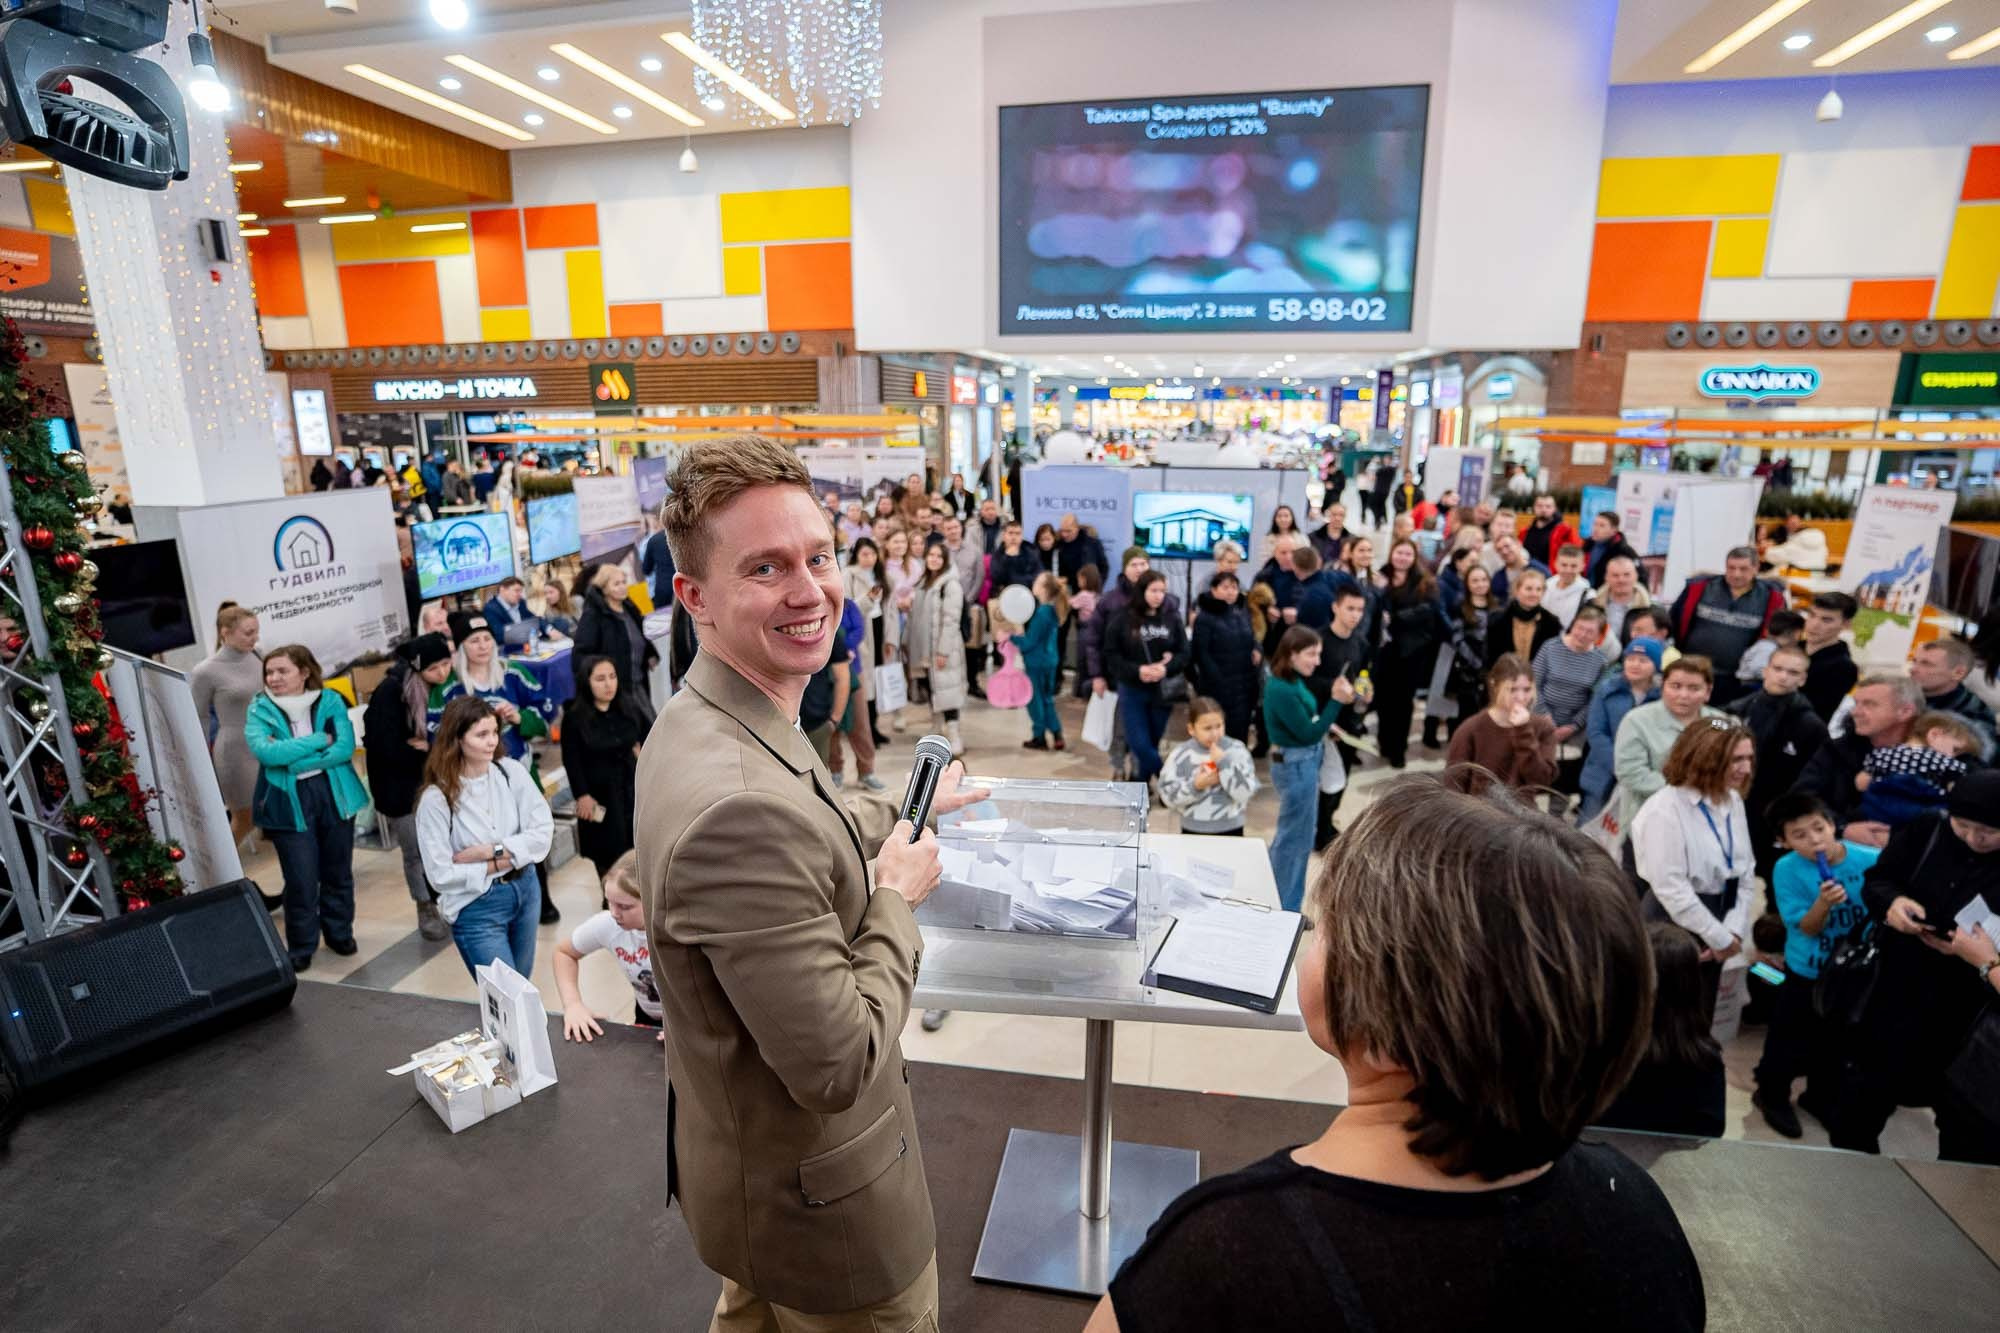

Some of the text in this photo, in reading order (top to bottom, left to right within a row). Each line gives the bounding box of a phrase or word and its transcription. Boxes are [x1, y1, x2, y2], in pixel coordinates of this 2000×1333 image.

[1084, 107, 1149, 124] Тайская
[1145, 118, 1268, 139] Скидки от 20%
[1017, 305, 1073, 320] Ленина
[1075, 303, 1099, 320] 43,
[1100, 303, 1145, 319] "Сити
[1206, 303, 1217, 318] 2
[1219, 304, 1256, 318] этаж
[1268, 297, 1387, 321] 58-98-02
[475, 377, 537, 398] ТОЧКА
[1706, 372, 1813, 390] CINNABON
[269, 565, 347, 591] ГУДВИЛЛ
[252, 577, 384, 614] ОИТЕЛЬСТВО ЗАГОРОДНОЙ
[271, 595, 355, 621] НЕДВИЖИМОСТИ
